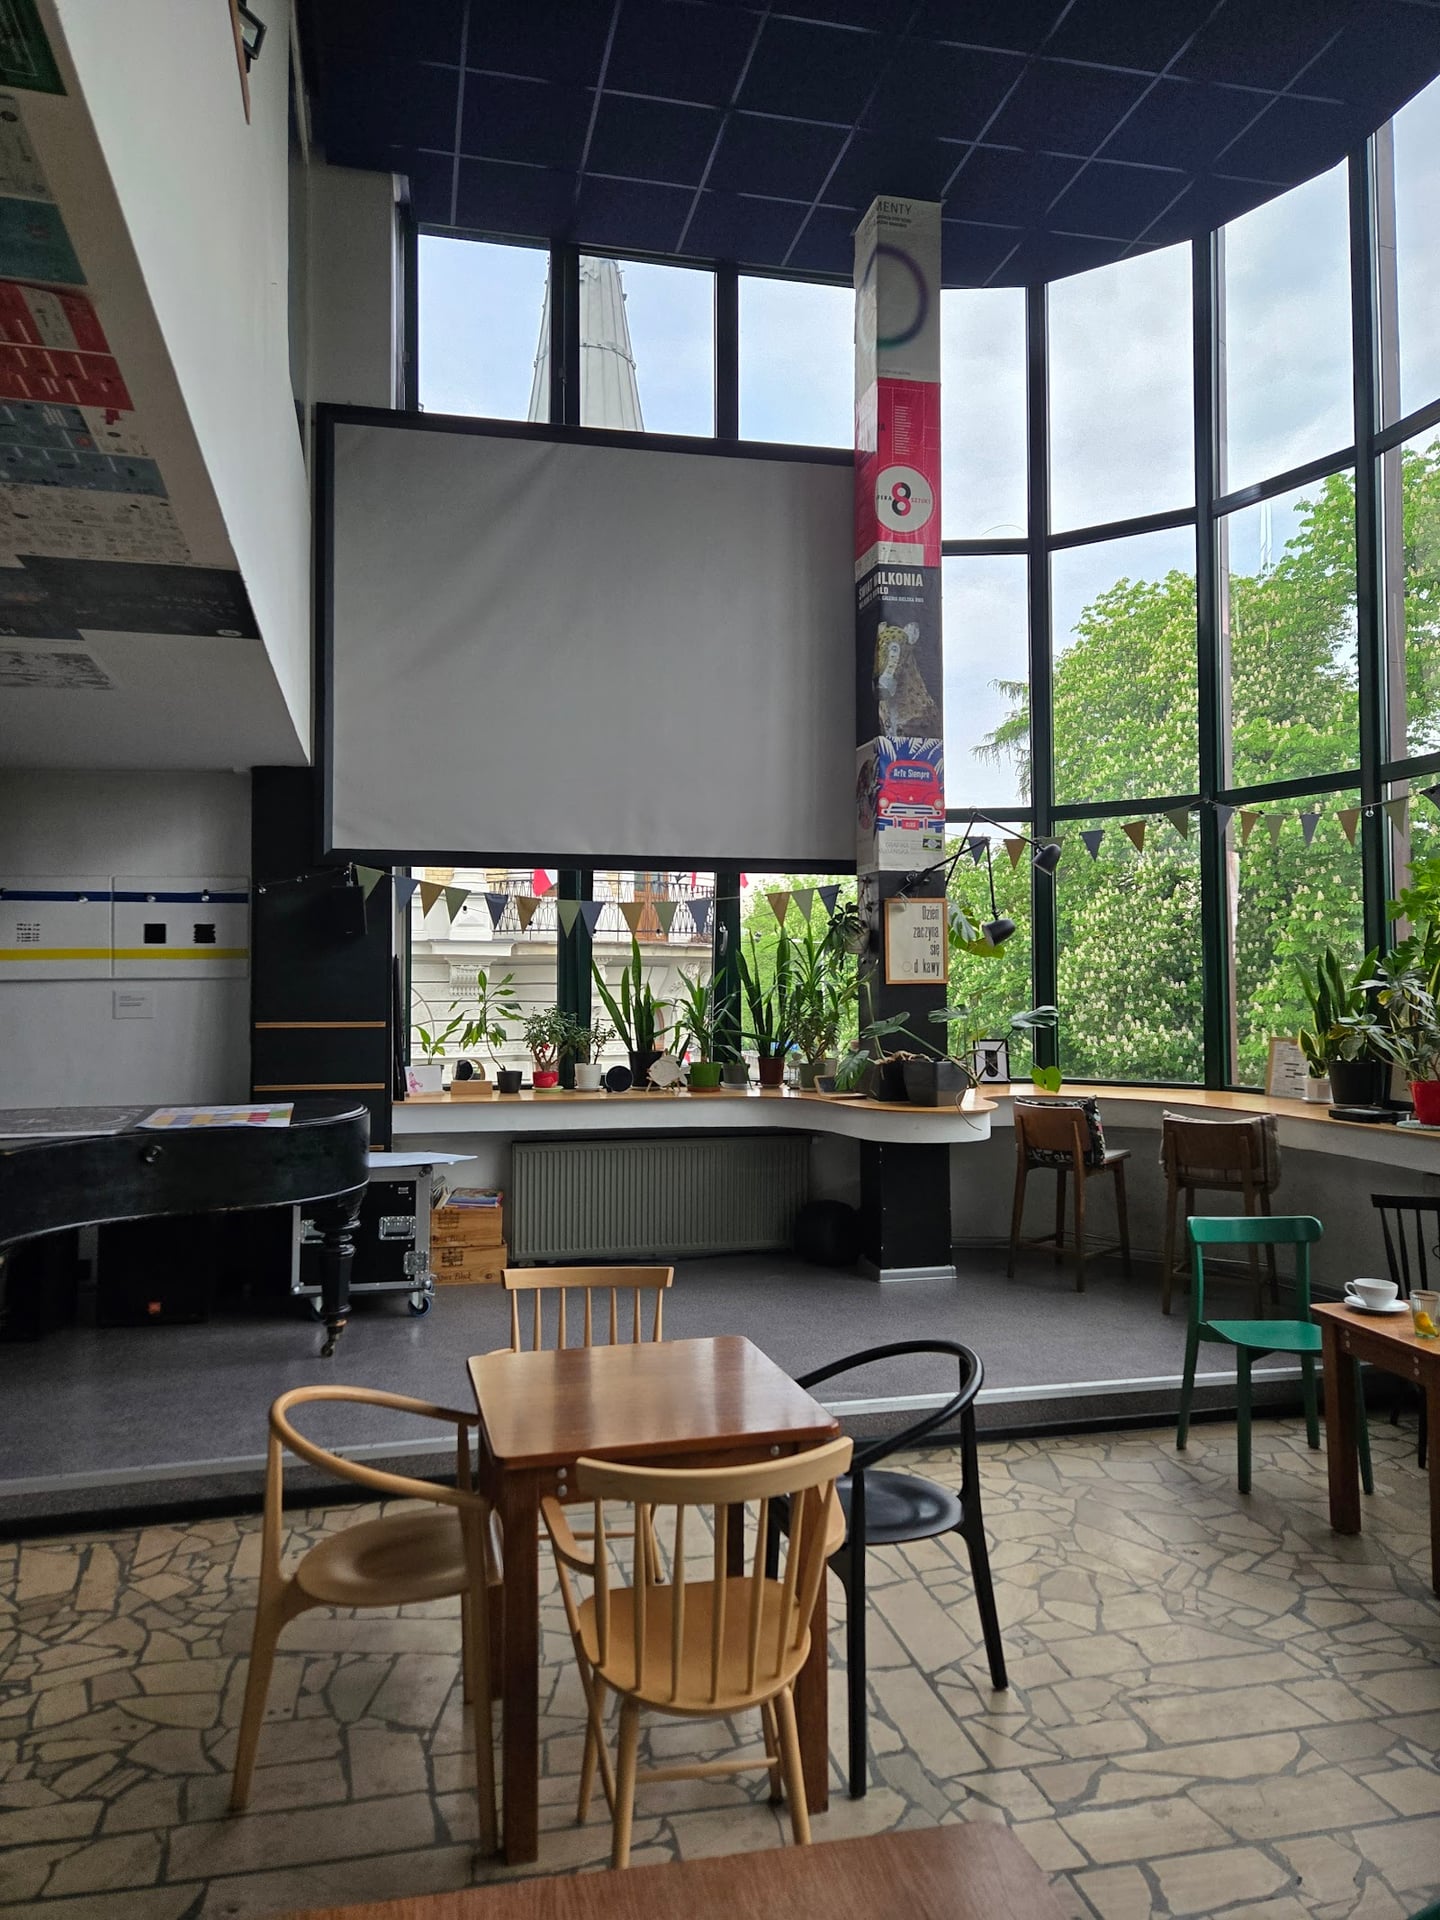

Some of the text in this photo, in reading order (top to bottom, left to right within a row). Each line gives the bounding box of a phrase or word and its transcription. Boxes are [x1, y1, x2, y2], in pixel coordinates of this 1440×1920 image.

[922, 905, 940, 920] Dzień
[913, 926, 940, 941] zaczyna
[930, 940, 940, 957] się
[922, 959, 940, 976] kawy
